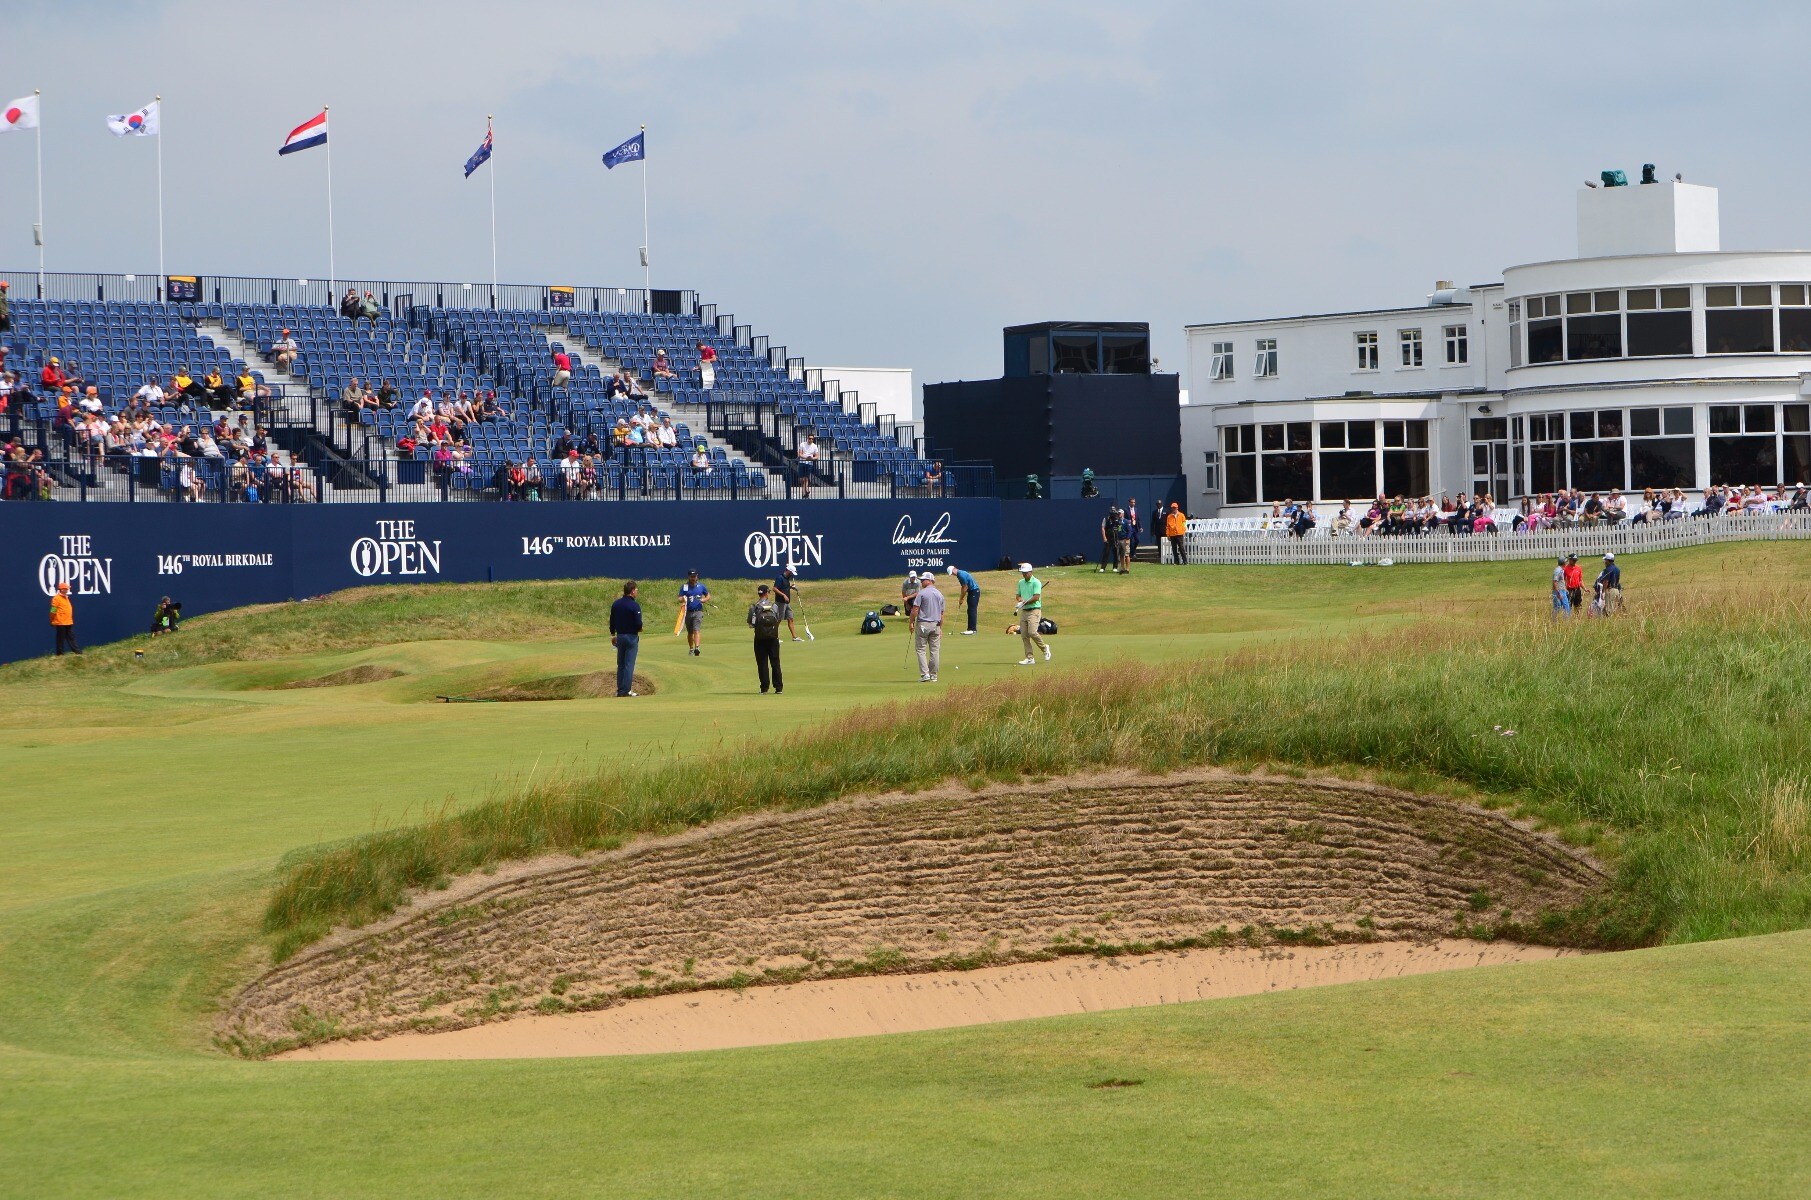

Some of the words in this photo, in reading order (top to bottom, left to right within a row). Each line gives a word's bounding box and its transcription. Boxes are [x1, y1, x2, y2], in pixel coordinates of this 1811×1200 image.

[375, 520, 416, 540] THE
[766, 515, 801, 534] THE
[59, 535, 92, 556] THE
[566, 535, 606, 548] ROYAL
[608, 534, 671, 547] BIRKDALE
[744, 531, 824, 568] OPEN
[192, 554, 224, 567] ROYAL
[225, 553, 273, 566] BIRKDALE
[350, 537, 442, 577] OPEN
[900, 548, 925, 556] ARNOLD
[907, 557, 944, 568] 1929-2016
[38, 553, 113, 597] OPEN
